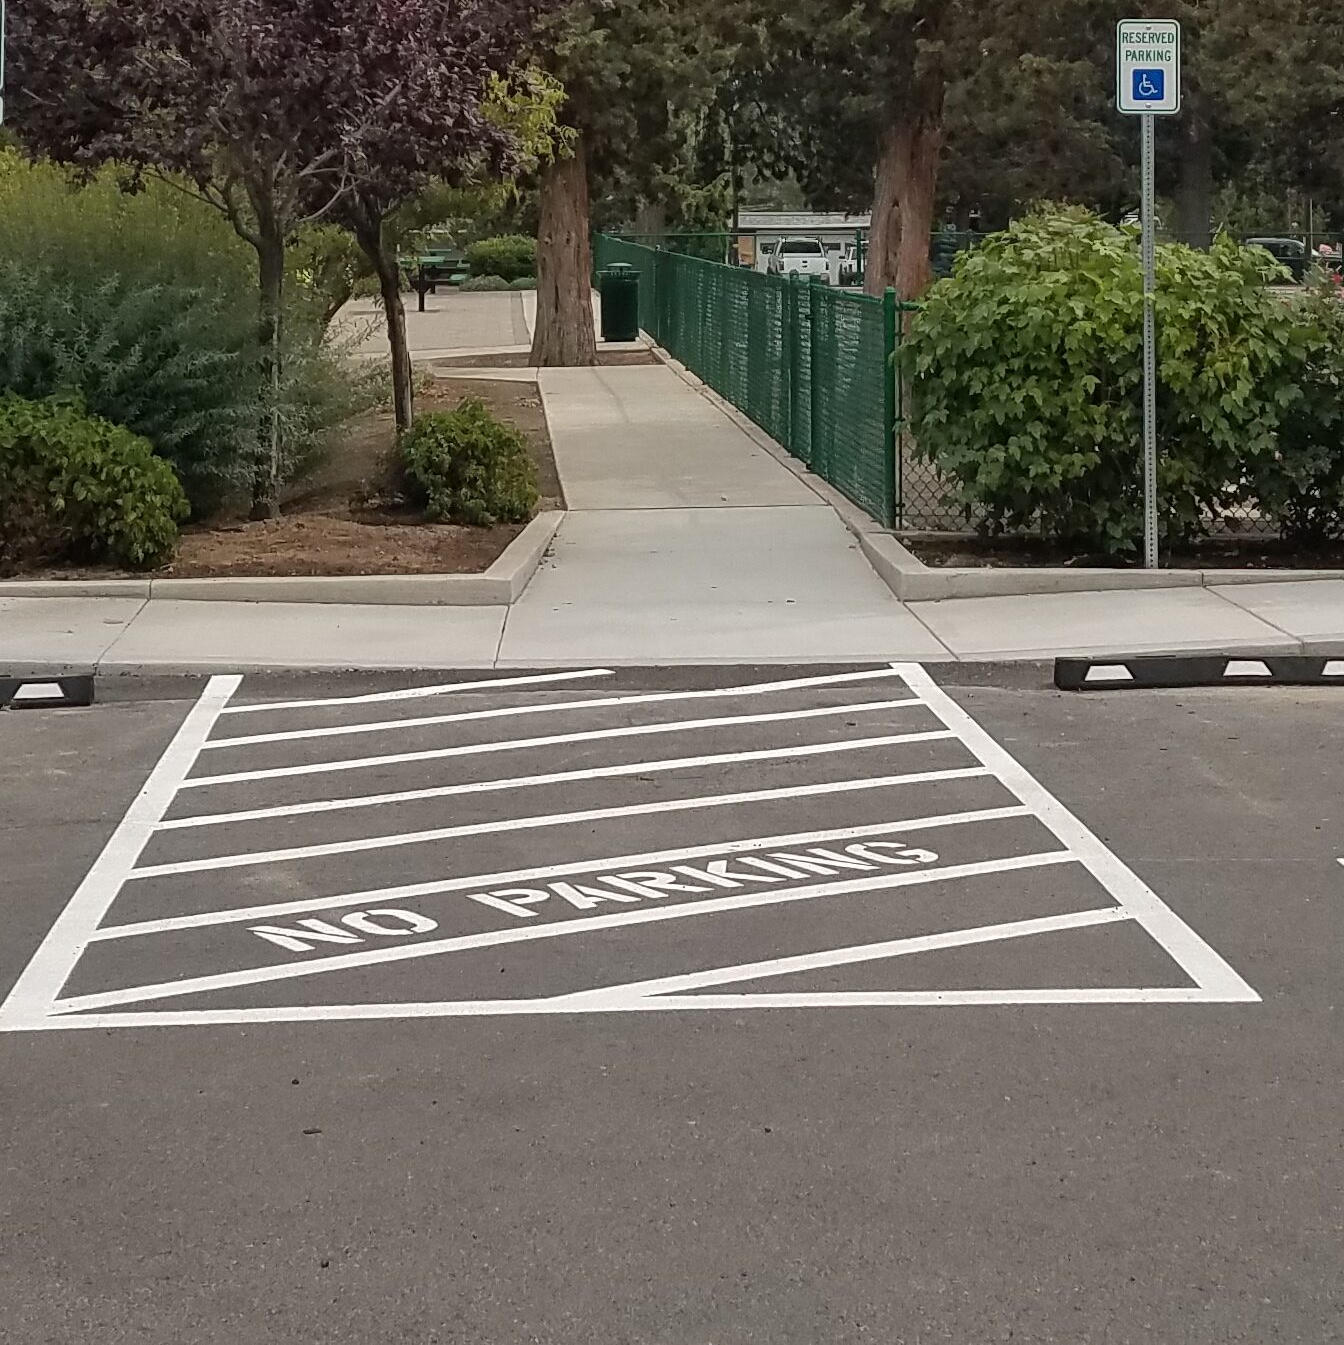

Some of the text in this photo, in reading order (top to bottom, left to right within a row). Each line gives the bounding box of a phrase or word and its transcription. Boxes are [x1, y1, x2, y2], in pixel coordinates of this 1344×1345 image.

[1122, 32, 1174, 44] RESERVED
[1125, 49, 1172, 62] PARKING
[247, 841, 940, 953] NO PARKING
